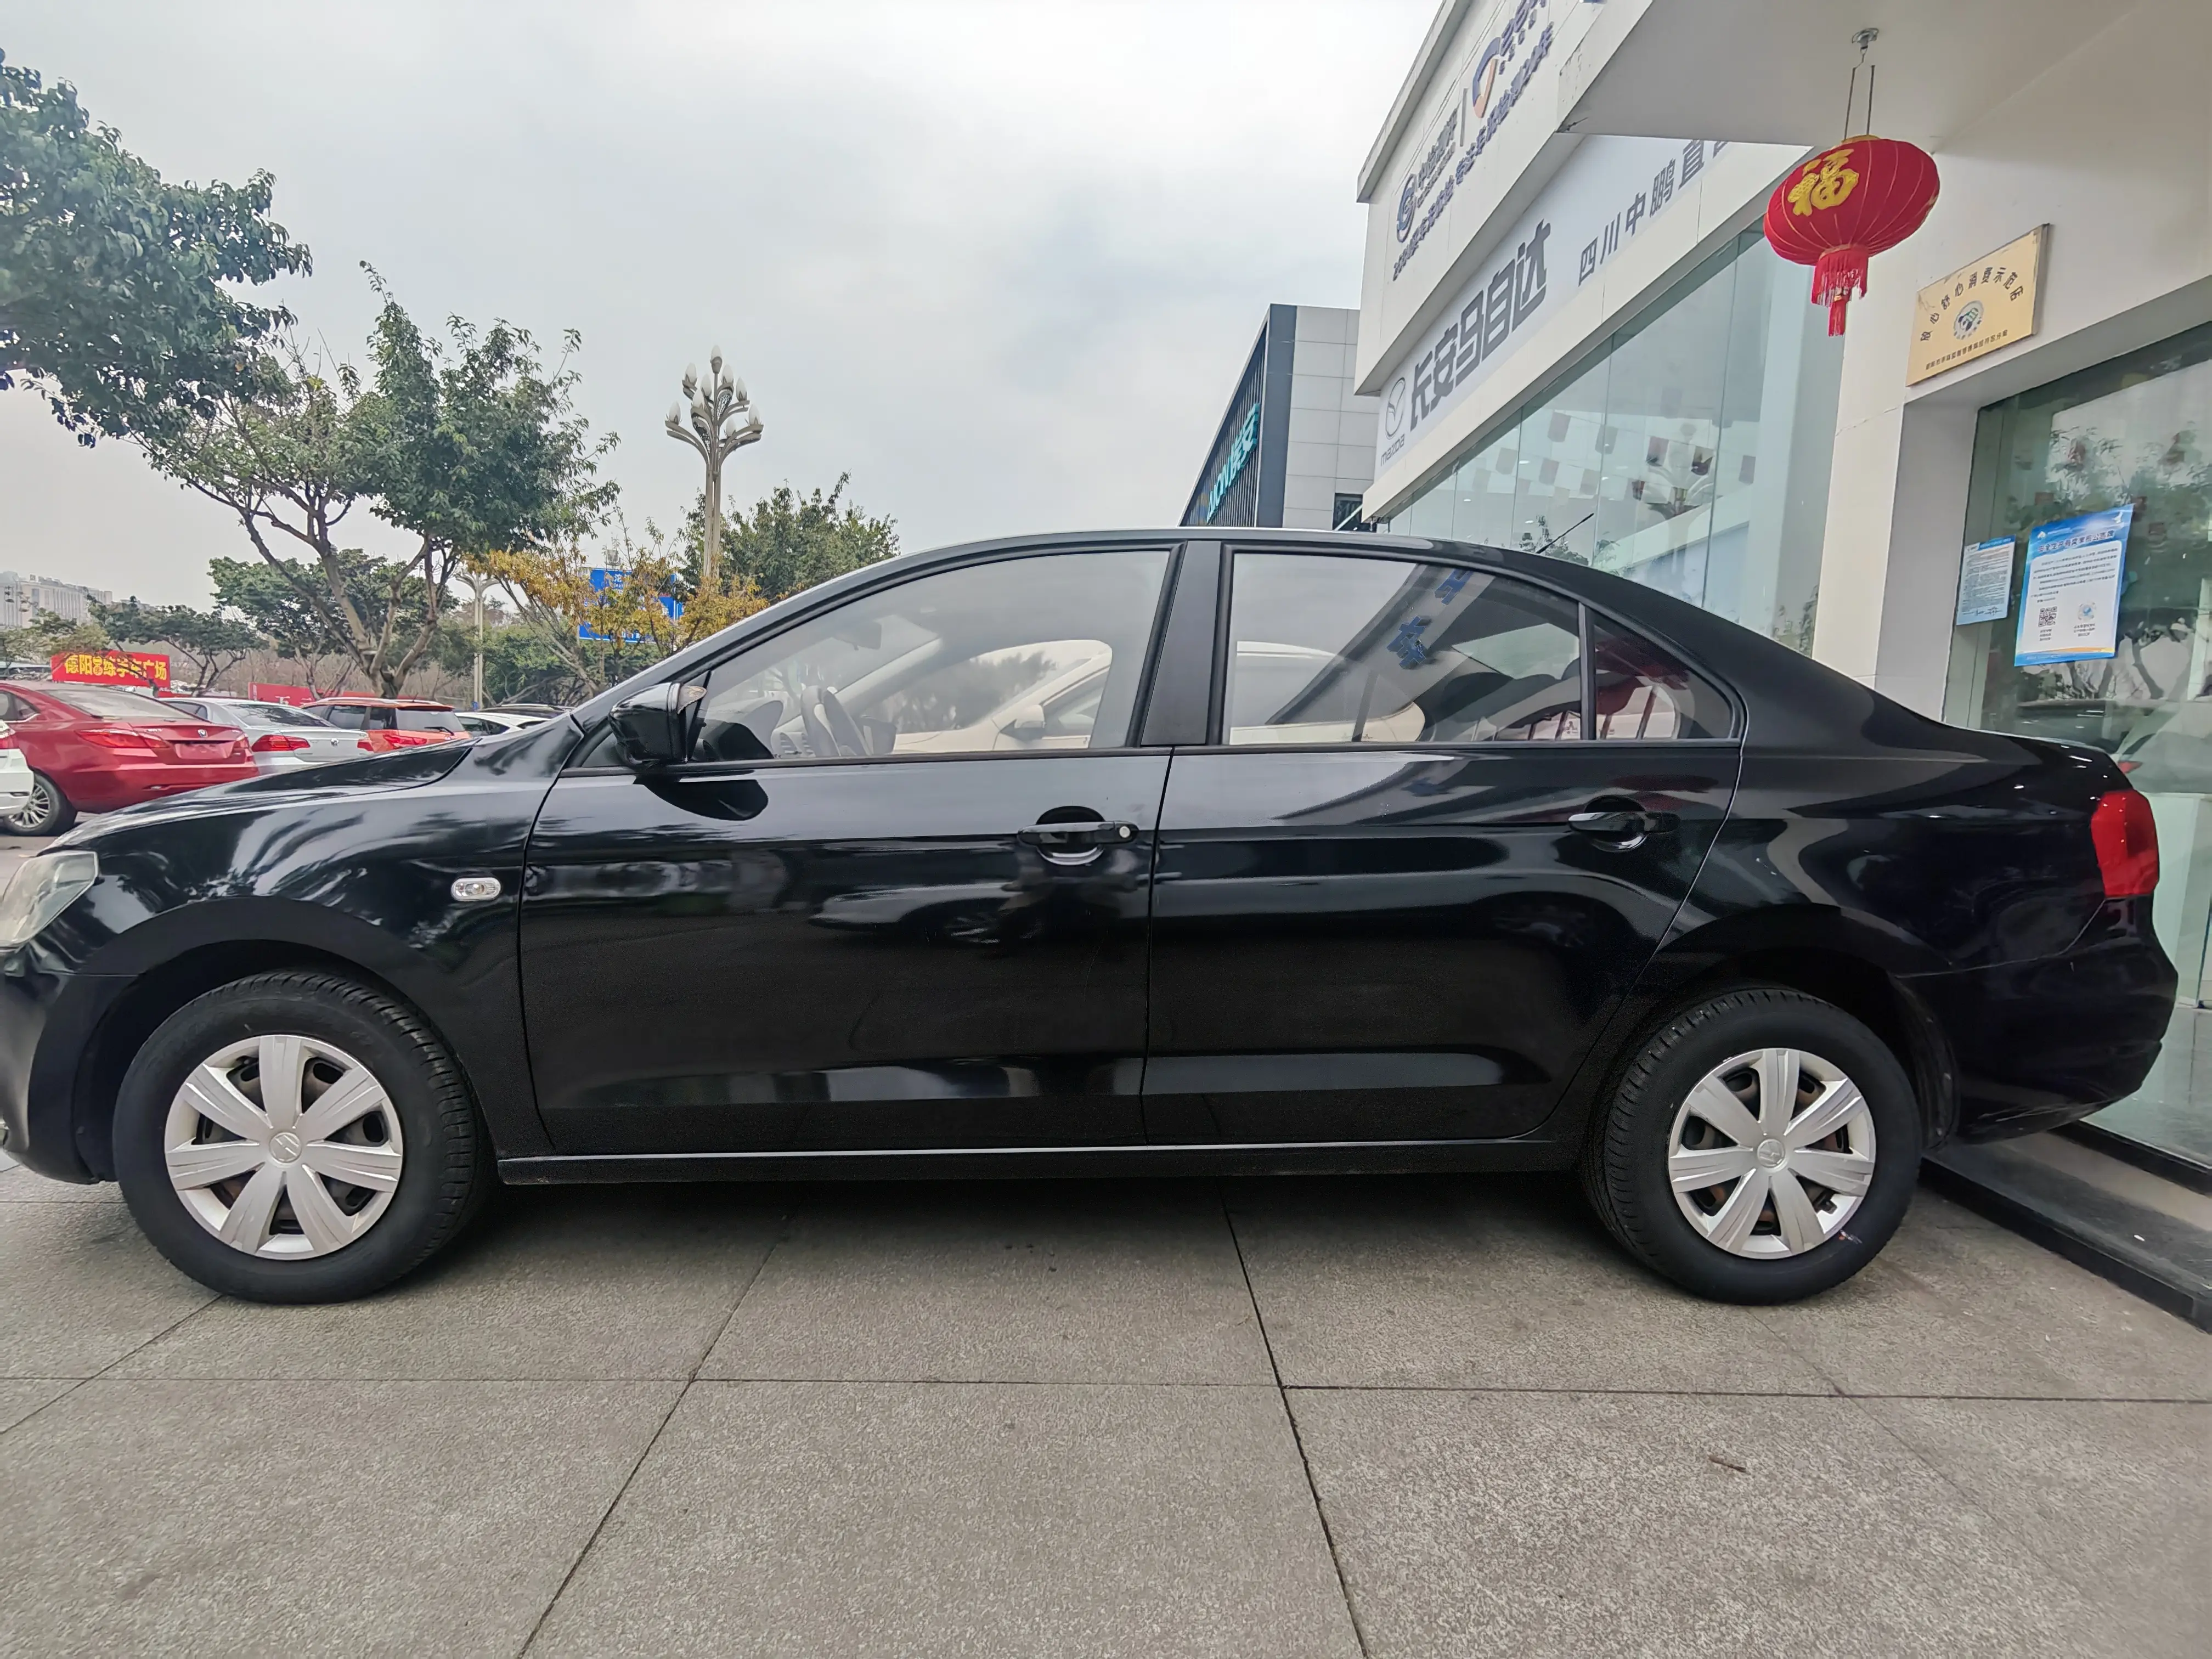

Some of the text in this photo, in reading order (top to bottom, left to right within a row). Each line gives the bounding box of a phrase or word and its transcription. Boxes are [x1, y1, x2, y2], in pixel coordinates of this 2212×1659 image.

[1578, 139, 1729, 287] 四川中鹏直
[1787, 149, 1860, 216] 福
[1410, 218, 1551, 432] 长安马自达
